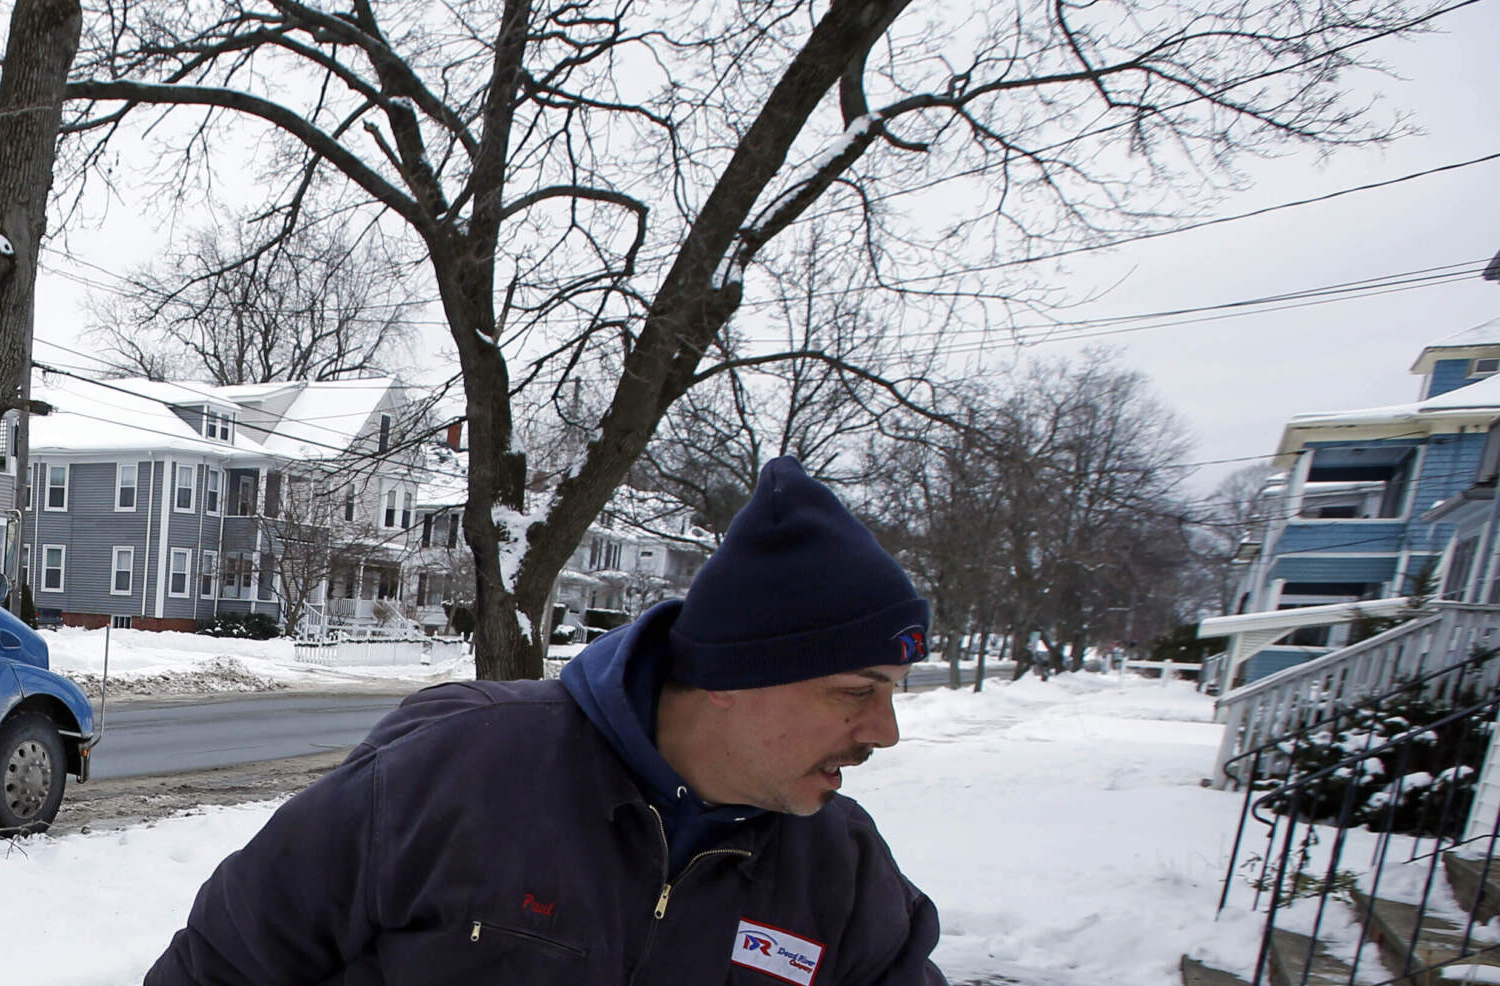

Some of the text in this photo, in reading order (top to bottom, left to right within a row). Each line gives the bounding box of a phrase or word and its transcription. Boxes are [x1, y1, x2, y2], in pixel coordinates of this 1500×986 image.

[522, 893, 555, 917] Paul
[777, 946, 816, 967] Dead River
[789, 959, 813, 974] Company
